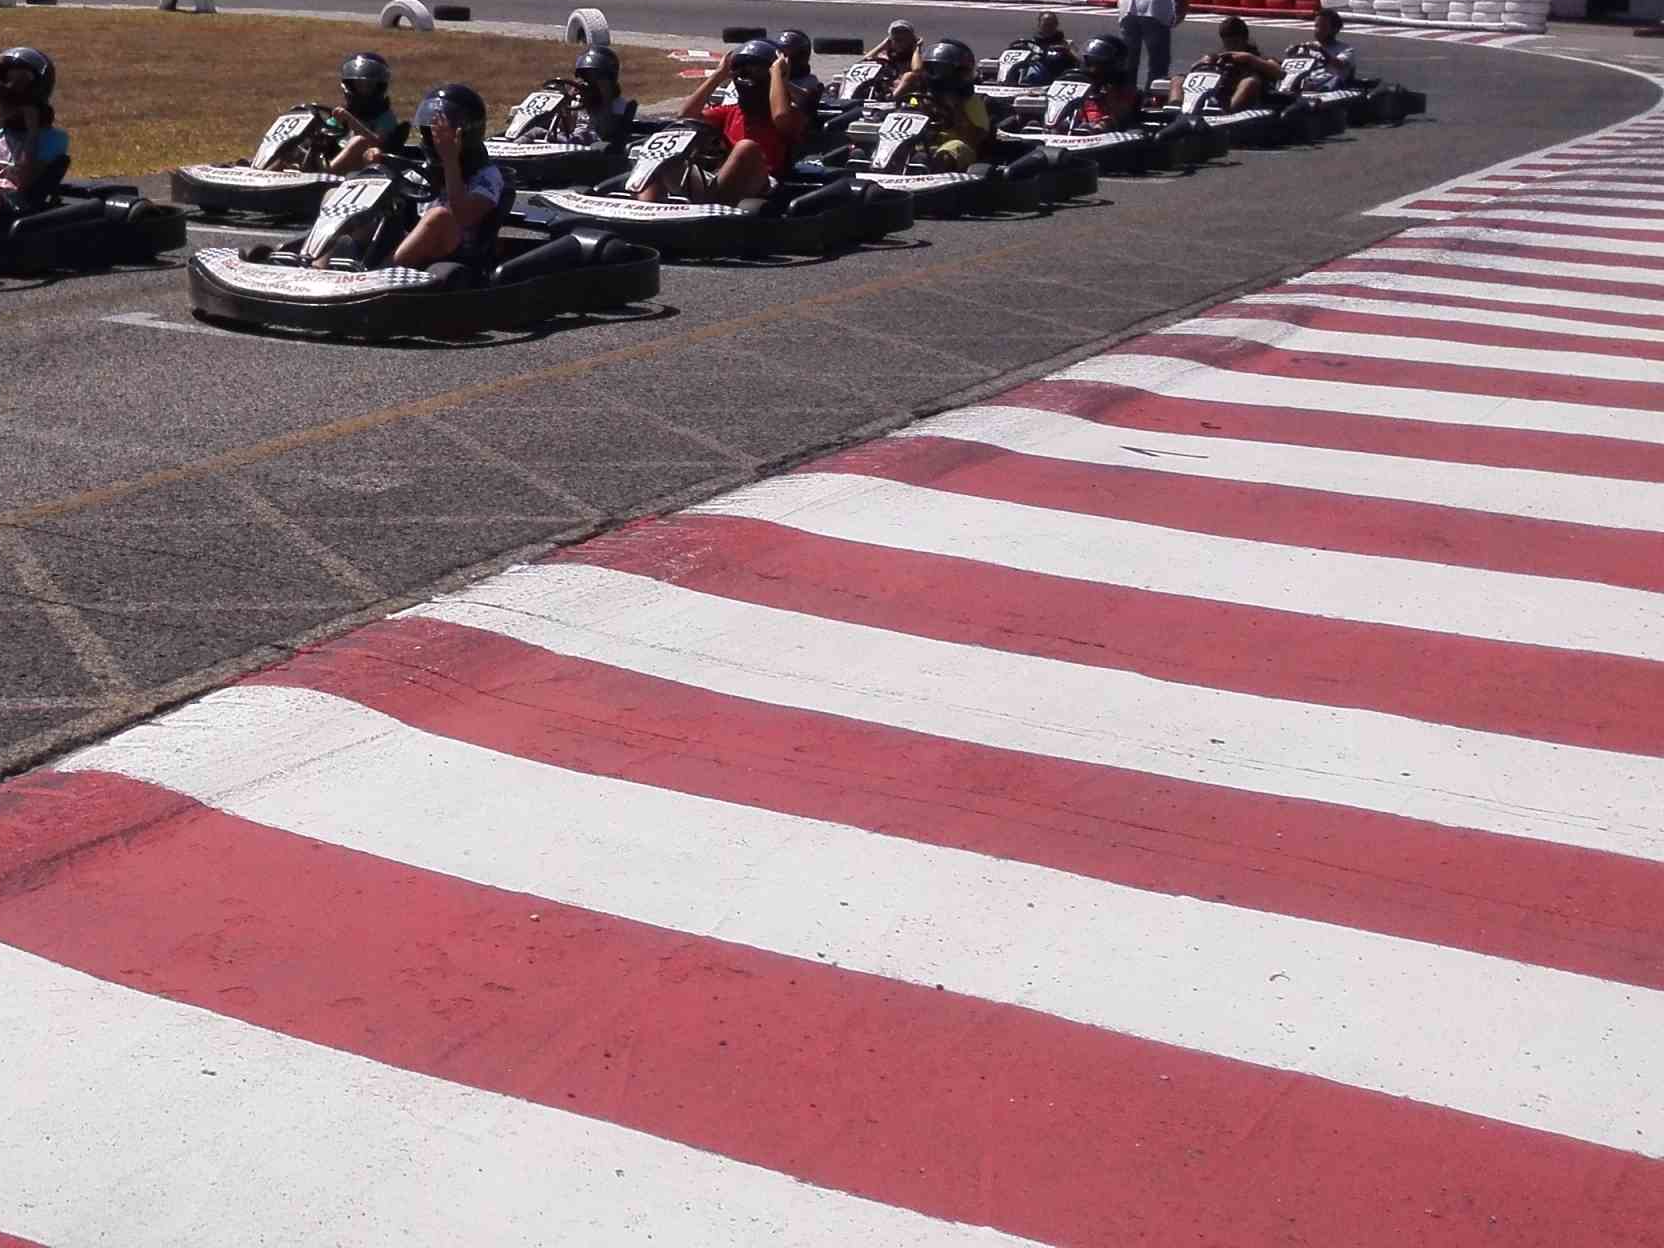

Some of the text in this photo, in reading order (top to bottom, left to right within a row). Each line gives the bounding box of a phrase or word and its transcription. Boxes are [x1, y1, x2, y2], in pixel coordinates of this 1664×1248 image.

[849, 64, 870, 78] 64
[1187, 74, 1207, 89] 61
[1055, 83, 1077, 96] 73
[527, 95, 550, 109] 63
[271, 117, 301, 137] 69
[888, 116, 913, 133] 70
[647, 135, 680, 152] 65
[334, 183, 367, 205] 71
[624, 202, 690, 213] KARTING
